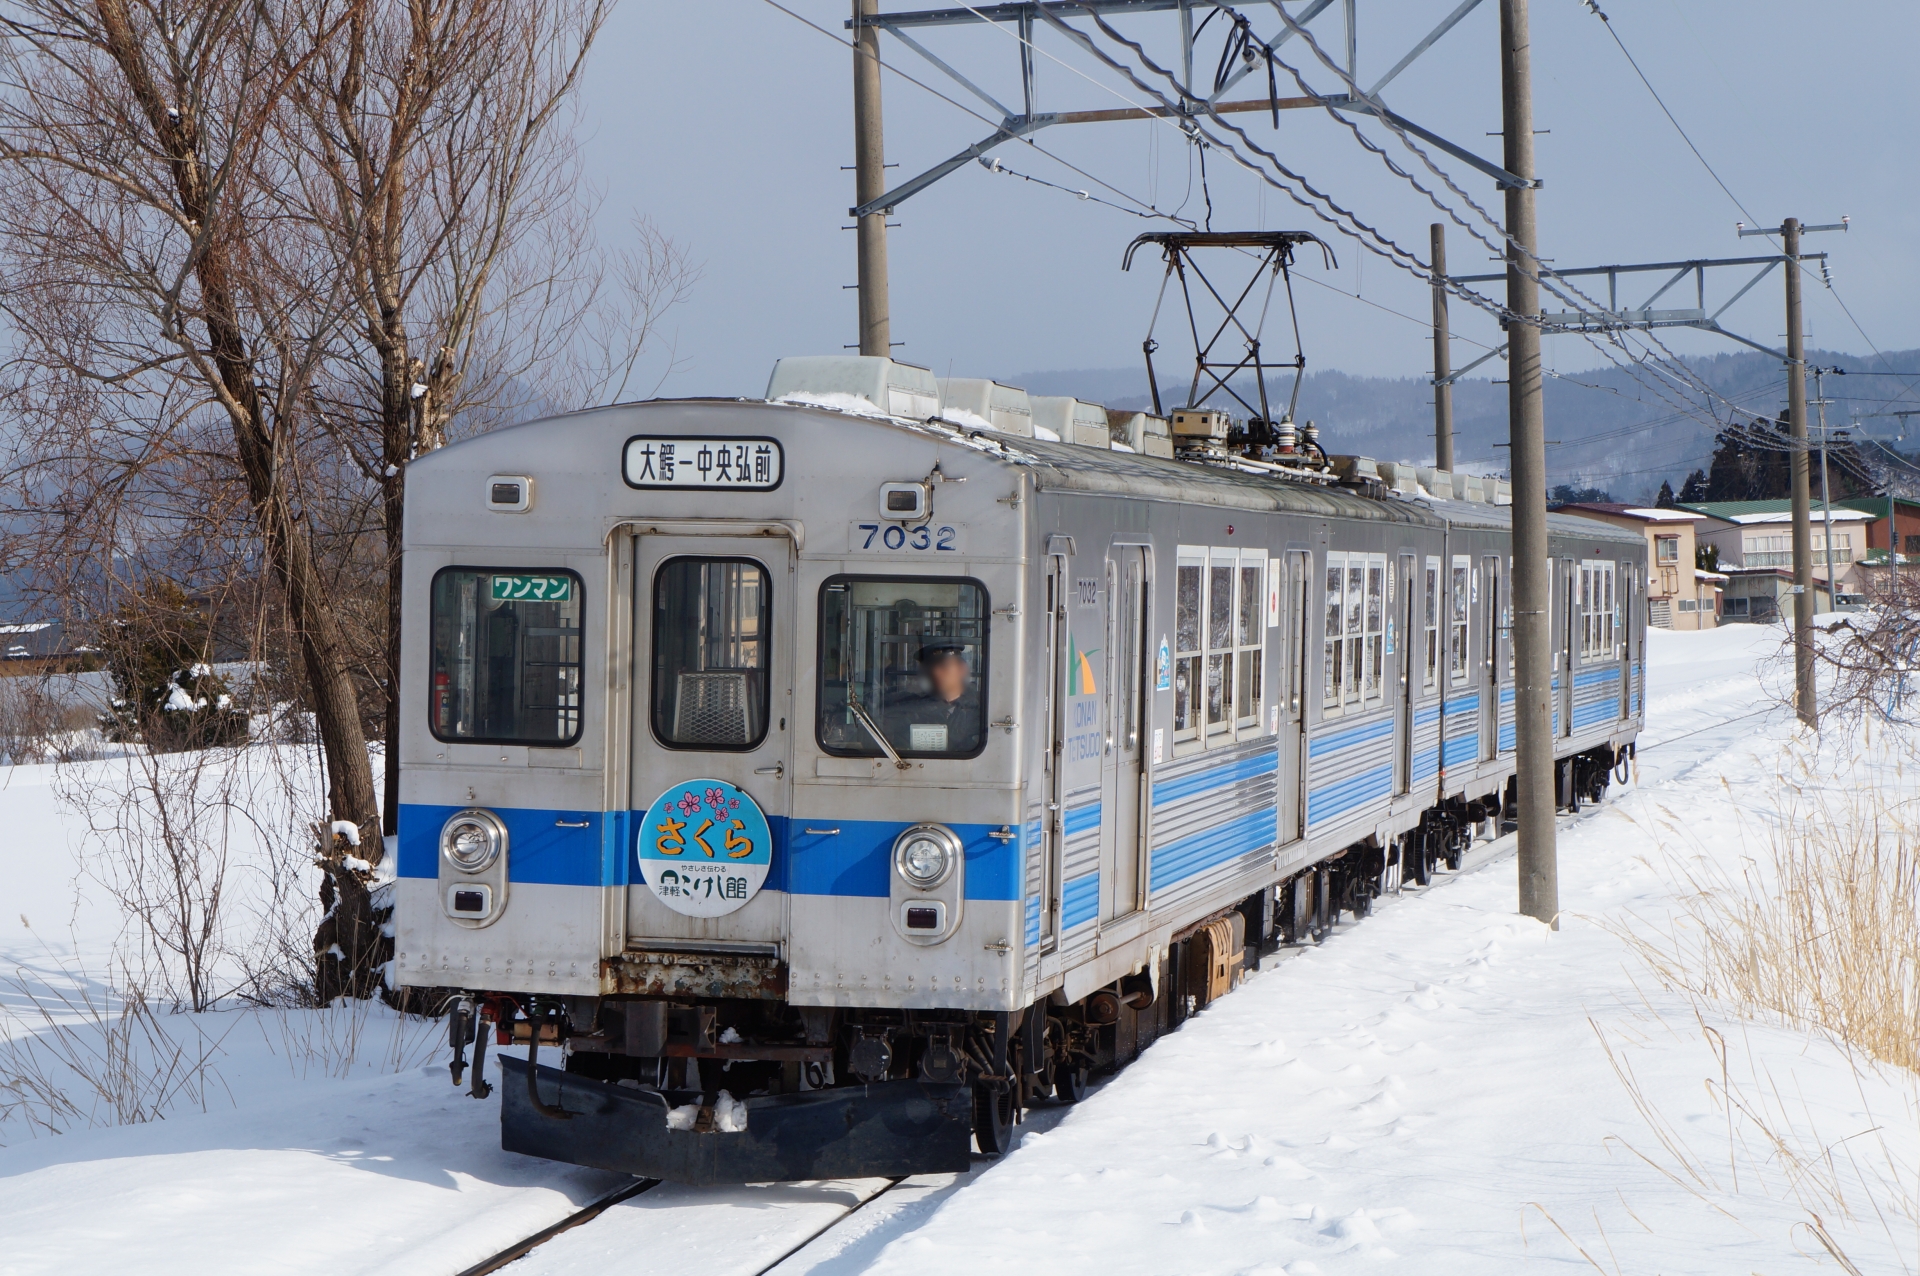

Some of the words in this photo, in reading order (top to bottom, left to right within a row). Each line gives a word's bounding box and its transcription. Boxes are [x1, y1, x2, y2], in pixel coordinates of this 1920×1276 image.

[858, 524, 956, 551] 7032
[495, 577, 568, 599] ワンマン
[1078, 581, 1097, 604] 7032
[1068, 731, 1100, 763] TETSUDO
[656, 817, 754, 858] さくら
[681, 865, 727, 873] やさしさ伝わる
